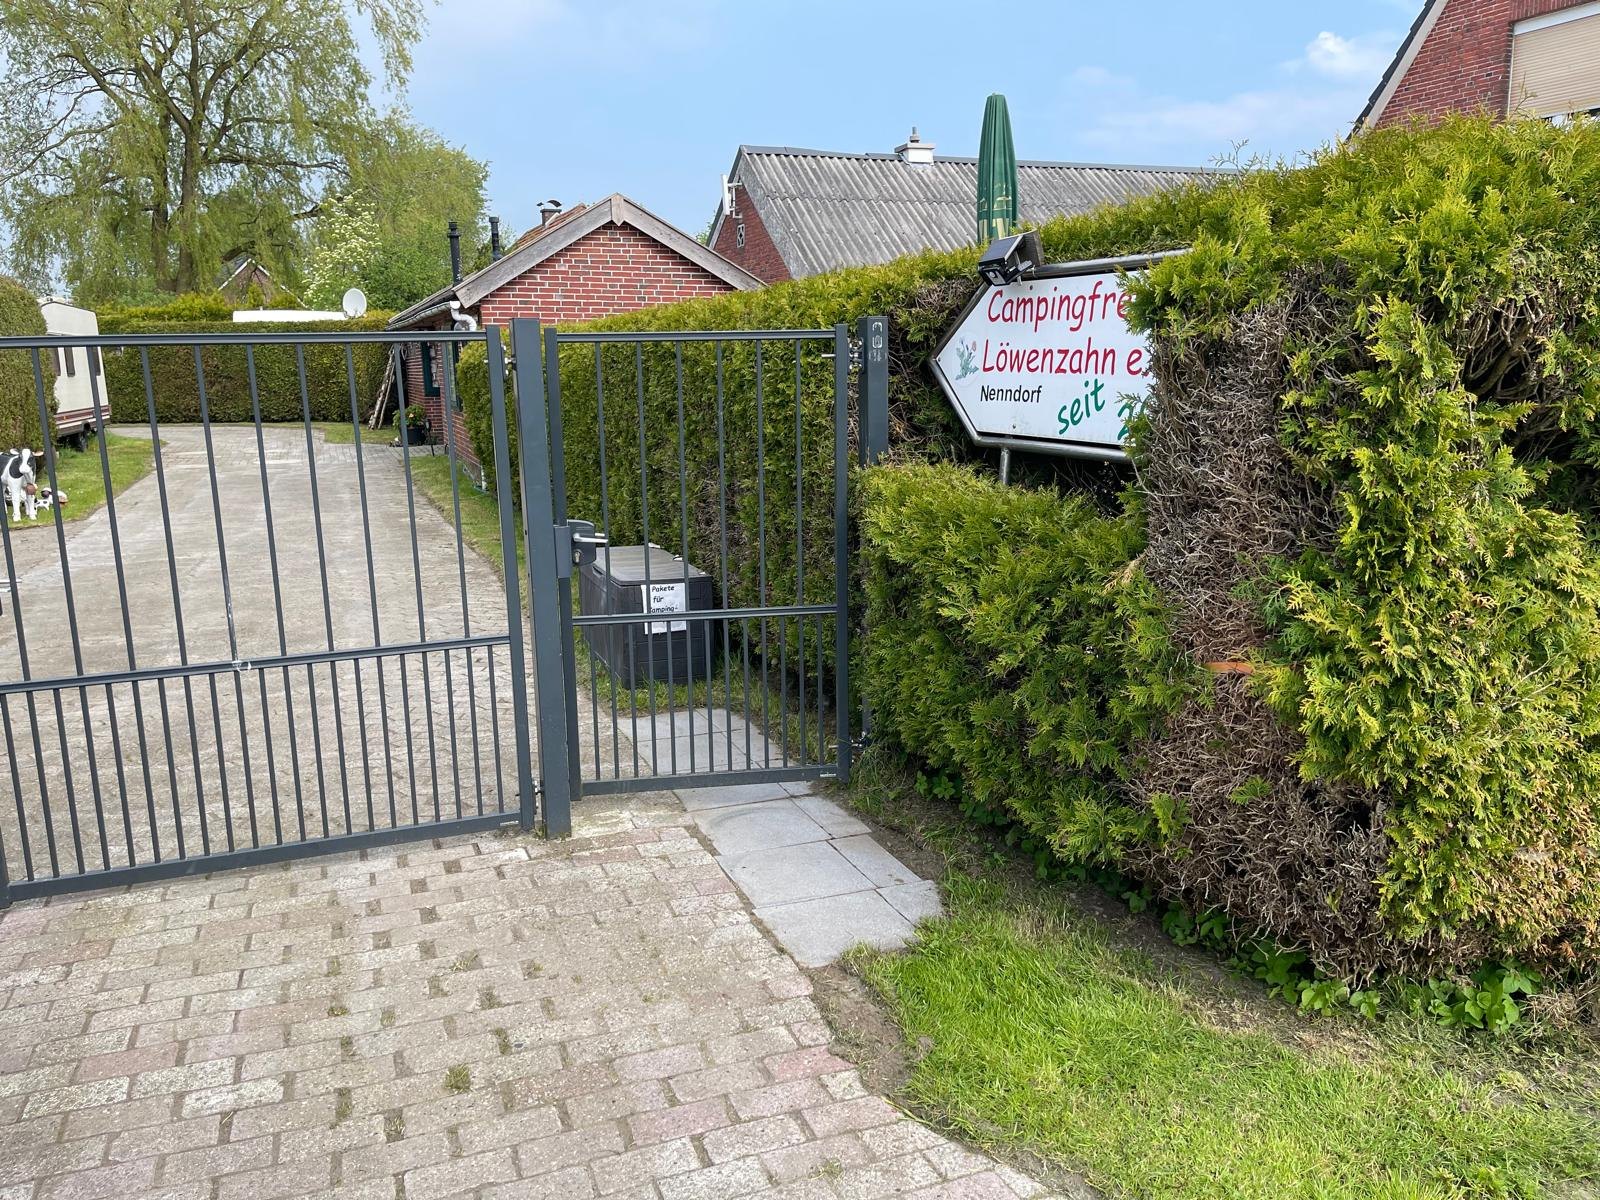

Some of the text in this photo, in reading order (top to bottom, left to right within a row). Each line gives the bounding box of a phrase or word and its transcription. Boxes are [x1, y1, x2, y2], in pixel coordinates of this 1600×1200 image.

[982, 336, 1116, 376] Löwenzahn
[980, 384, 1042, 403] Nenndorf
[1057, 378, 1106, 435] seit
[653, 595, 664, 603] für
